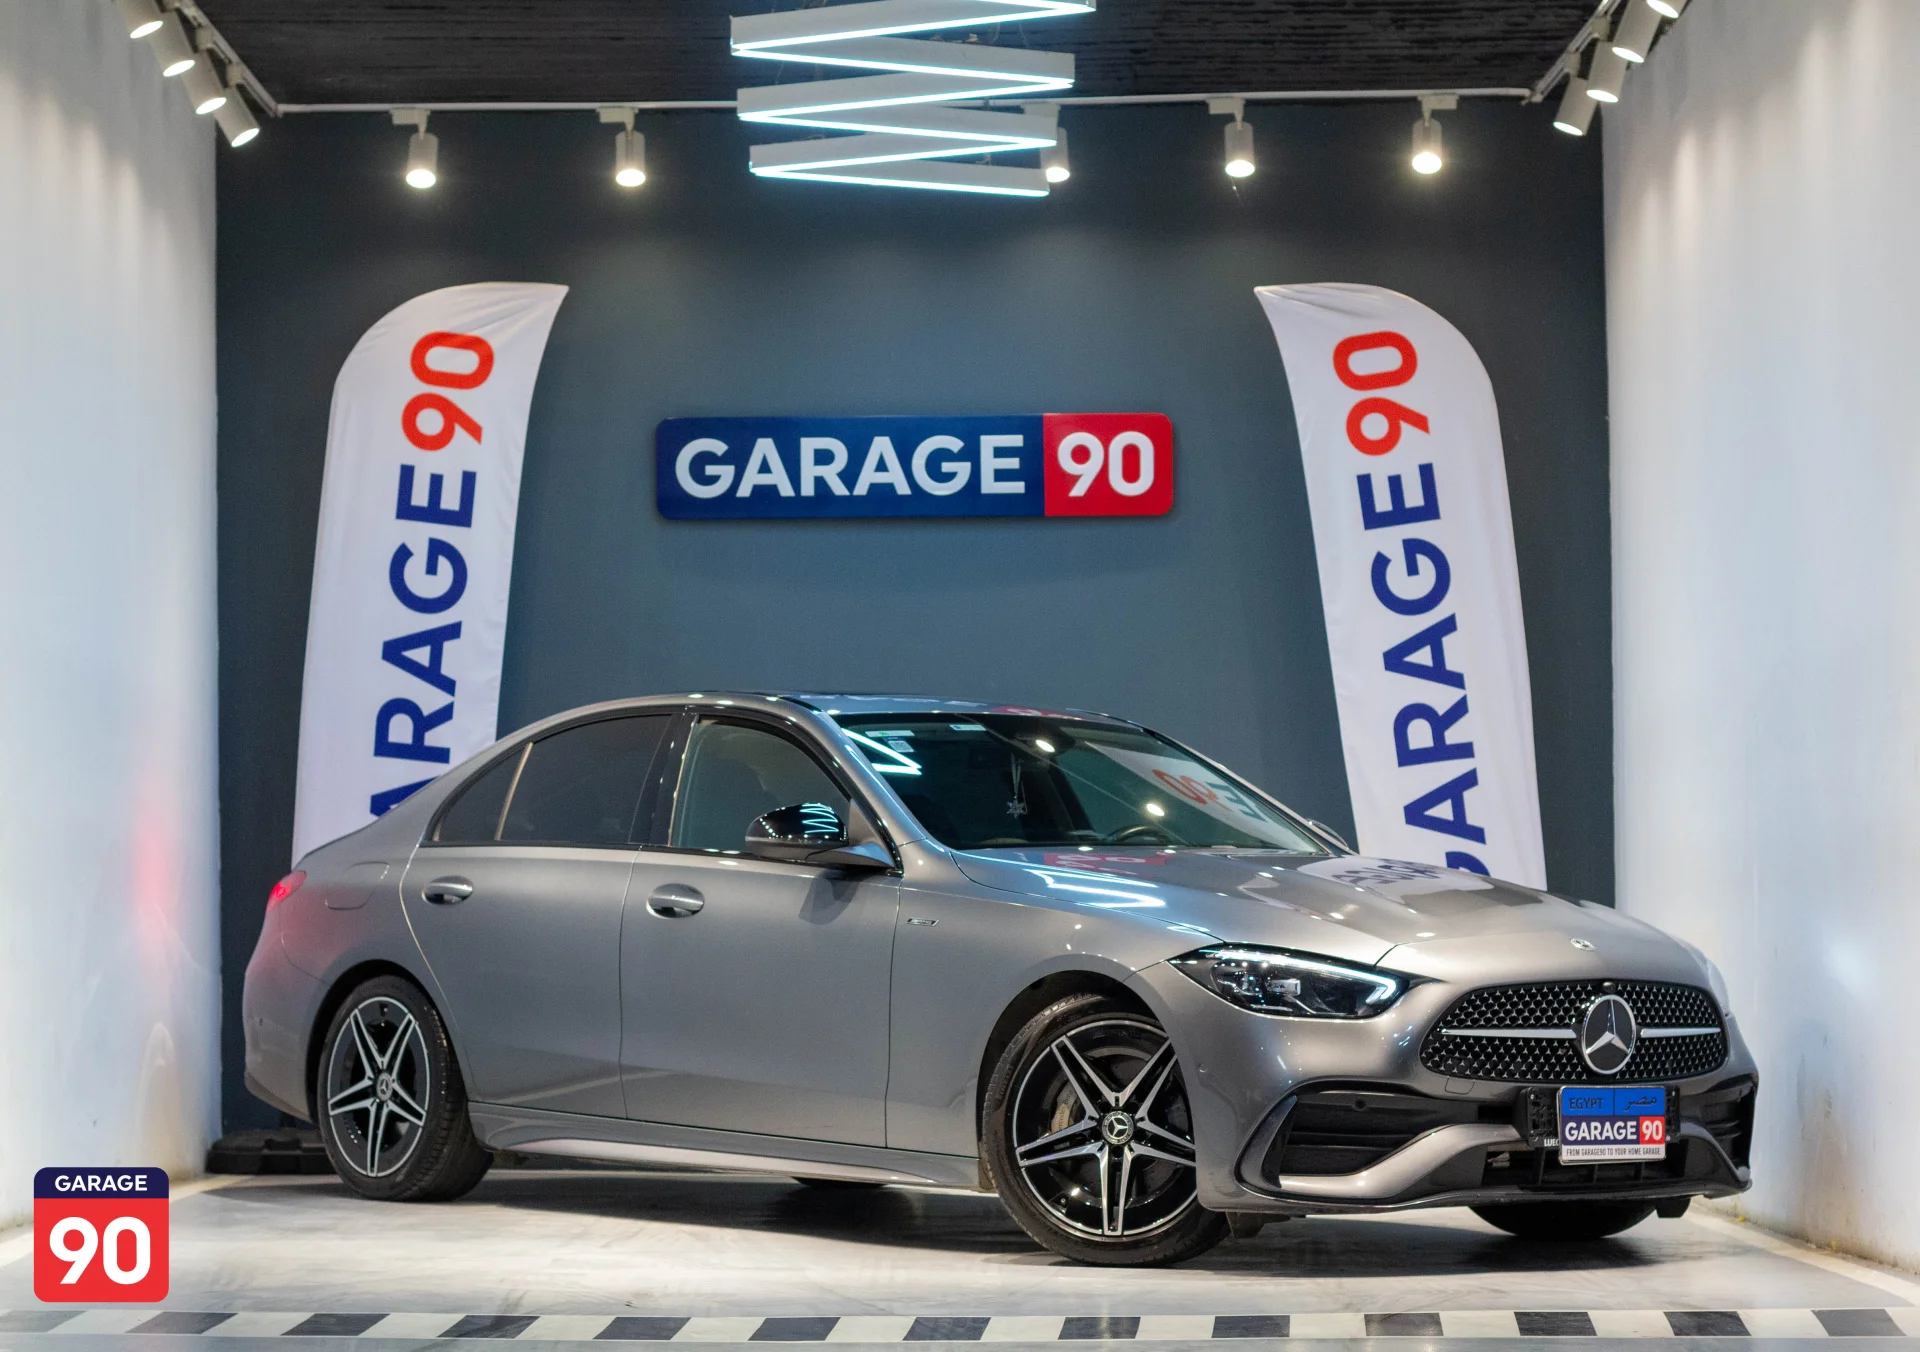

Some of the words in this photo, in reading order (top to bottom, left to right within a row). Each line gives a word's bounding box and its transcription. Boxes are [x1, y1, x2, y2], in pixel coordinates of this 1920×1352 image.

[675, 434, 1025, 498] GARAGE
[1057, 431, 1155, 497] 90
[1569, 1097, 1603, 1110] EGYPT
[1624, 1096, 1657, 1111] مصر
[1565, 1120, 1637, 1141] GARAGE
[1642, 1120, 1663, 1141] 90
[1566, 1148, 1580, 1156] FROM
[1607, 1148, 1613, 1156] TO
[1628, 1147, 1641, 1155] HOME
[1642, 1147, 1661, 1155] GARAGE
